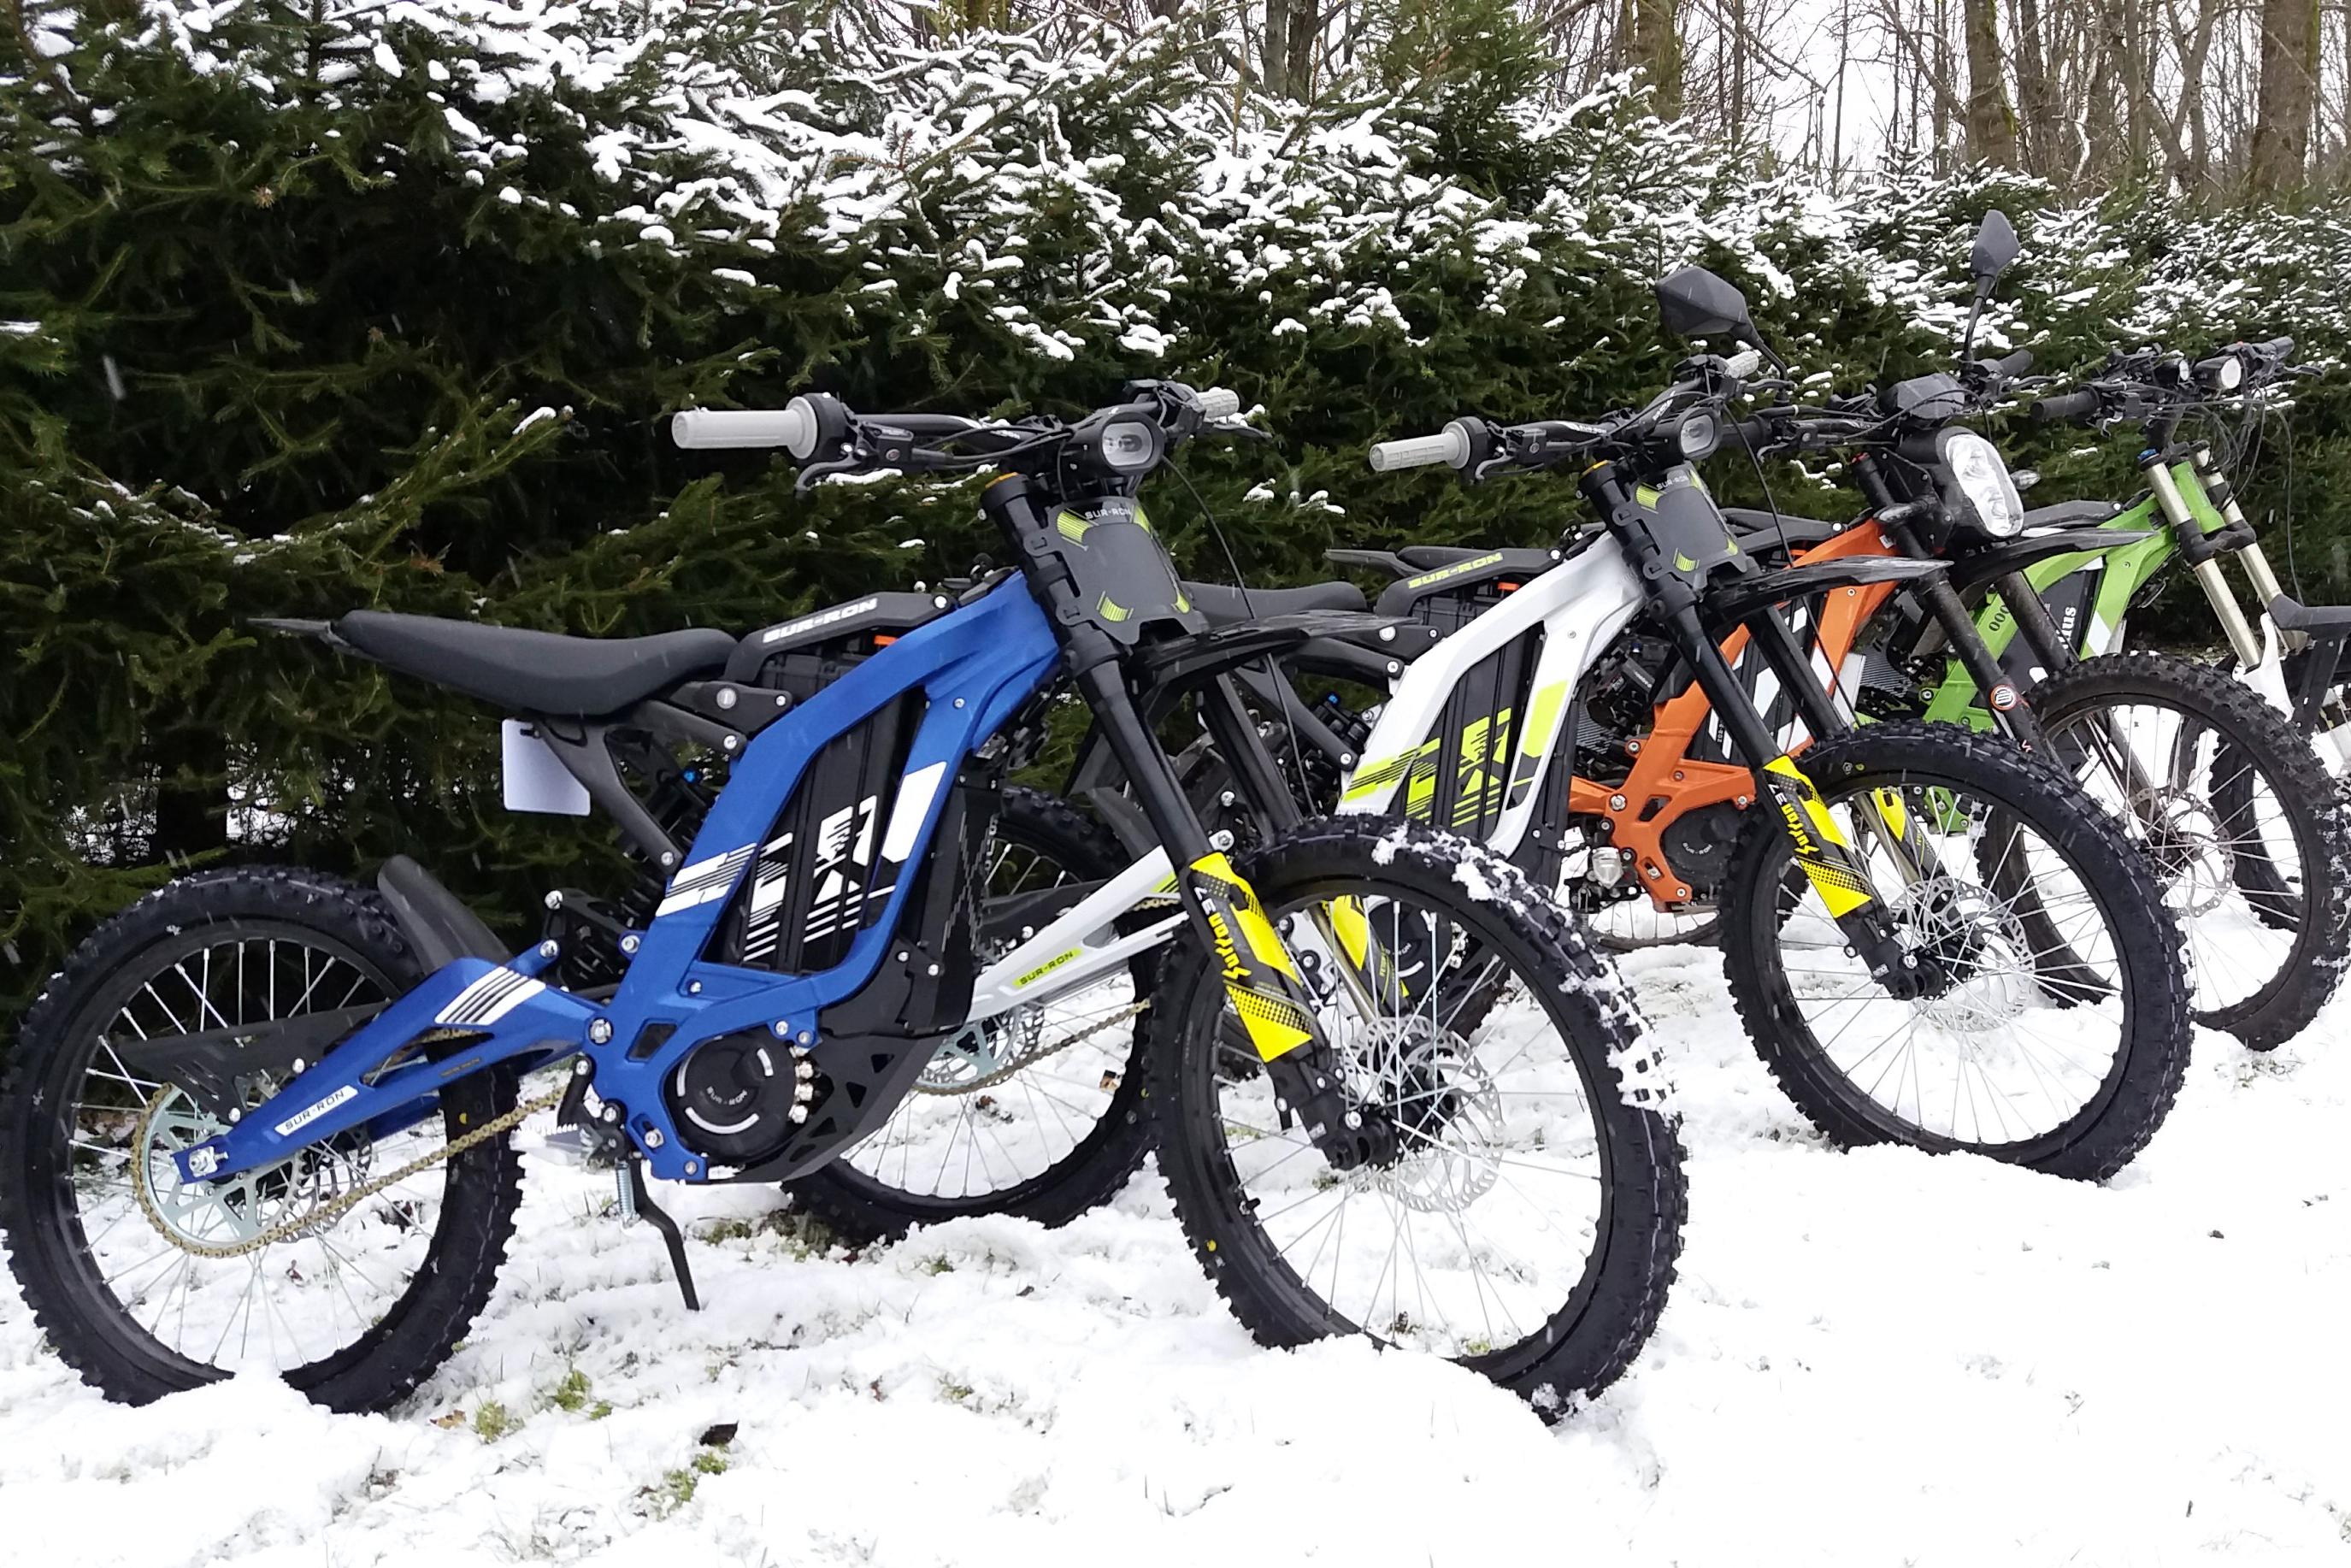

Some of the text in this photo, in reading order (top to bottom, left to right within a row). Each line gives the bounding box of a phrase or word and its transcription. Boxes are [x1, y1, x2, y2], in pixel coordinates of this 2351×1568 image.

[1085, 507, 1132, 520] SUR-RON
[1408, 551, 1504, 589] SUR-RON
[763, 598, 878, 644] SUR-RON
[1019, 951, 1074, 985] SUR-RON
[285, 1089, 345, 1130] SUR-RON
